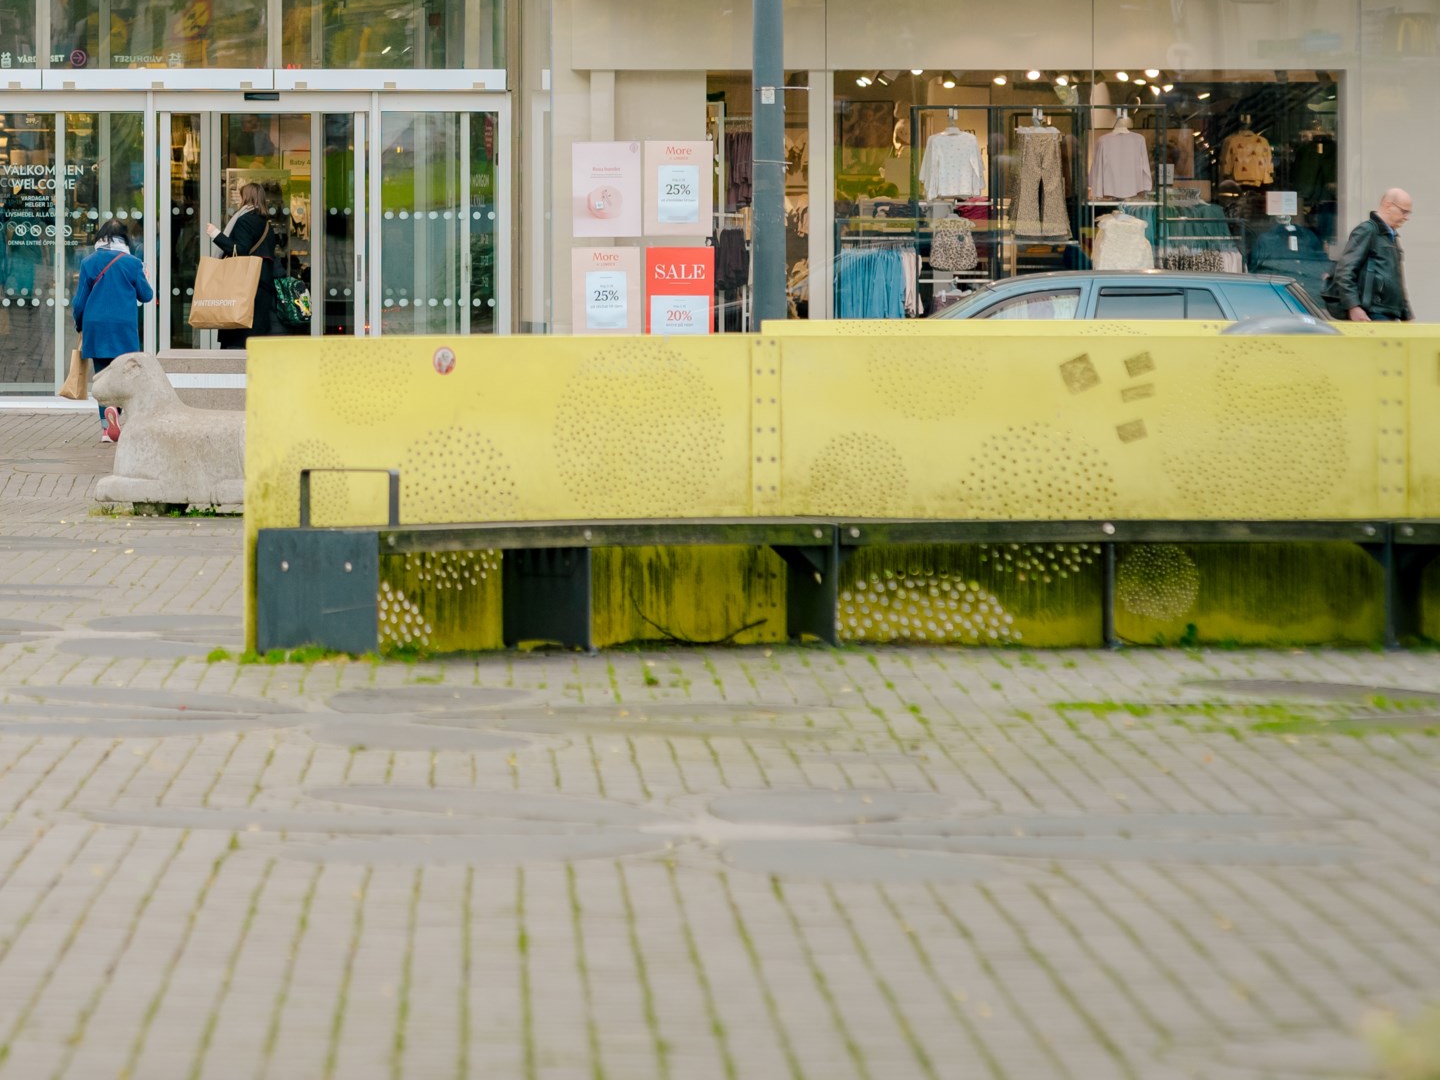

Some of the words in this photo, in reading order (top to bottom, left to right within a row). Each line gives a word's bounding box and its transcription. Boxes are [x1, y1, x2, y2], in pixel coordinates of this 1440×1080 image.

[665, 146, 692, 155] More
[3, 162, 84, 175] VÄLKOMEN
[11, 179, 76, 189] WELCOE
[665, 184, 691, 195] 25%
[593, 252, 620, 261] More
[655, 264, 706, 280] SALE
[594, 290, 620, 302] 25%
[666, 310, 693, 321] 20%
